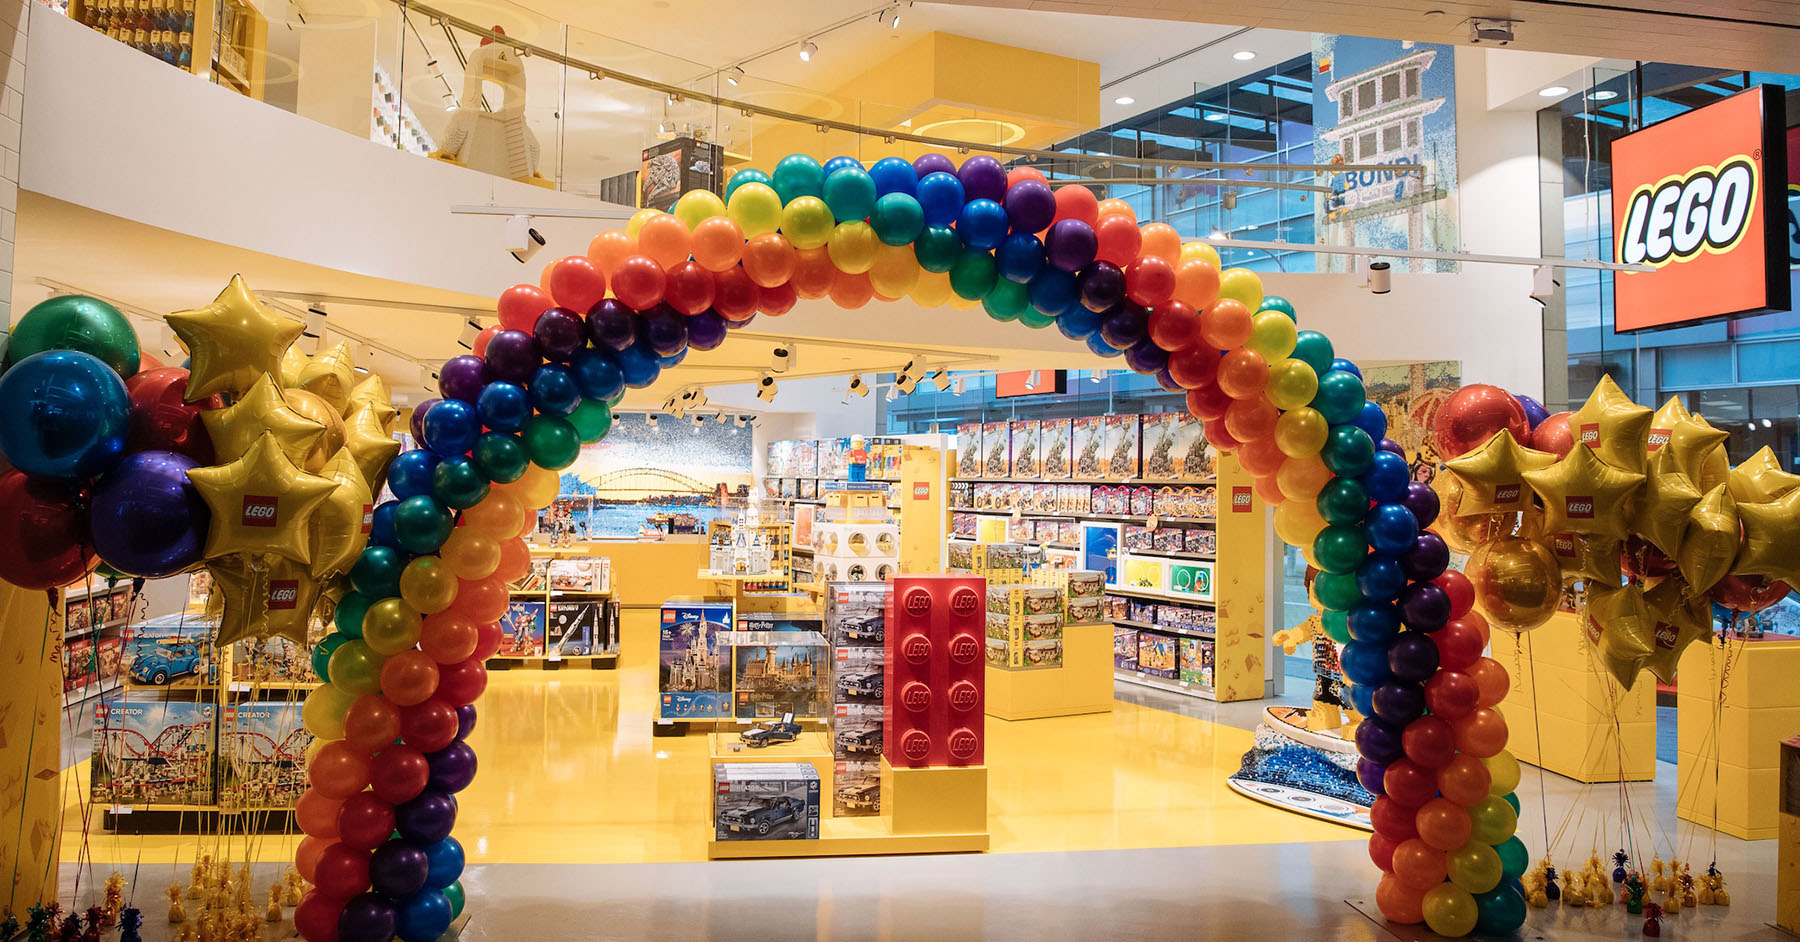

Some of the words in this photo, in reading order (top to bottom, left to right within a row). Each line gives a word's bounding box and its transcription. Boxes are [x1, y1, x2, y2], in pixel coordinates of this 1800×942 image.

[1622, 160, 1754, 266] LEGO
[1582, 430, 1599, 442] LEGO
[1234, 494, 1250, 505] LEGO
[1497, 489, 1519, 499] LEGO
[245, 505, 275, 518] LEGO
[1568, 502, 1593, 513] LEGO
[1556, 538, 1573, 550] LEGO
[271, 589, 296, 601] LEGO
[908, 595, 930, 609] LEGO
[954, 595, 976, 609] LEGO
[907, 643, 929, 656] LEGO
[954, 643, 975, 656] LEGO
[906, 691, 928, 704] LEGO
[953, 690, 975, 704] LEGO
[237, 711, 271, 719] CREATOR
[906, 739, 928, 753] LEGO
[953, 738, 975, 751] LEGO
